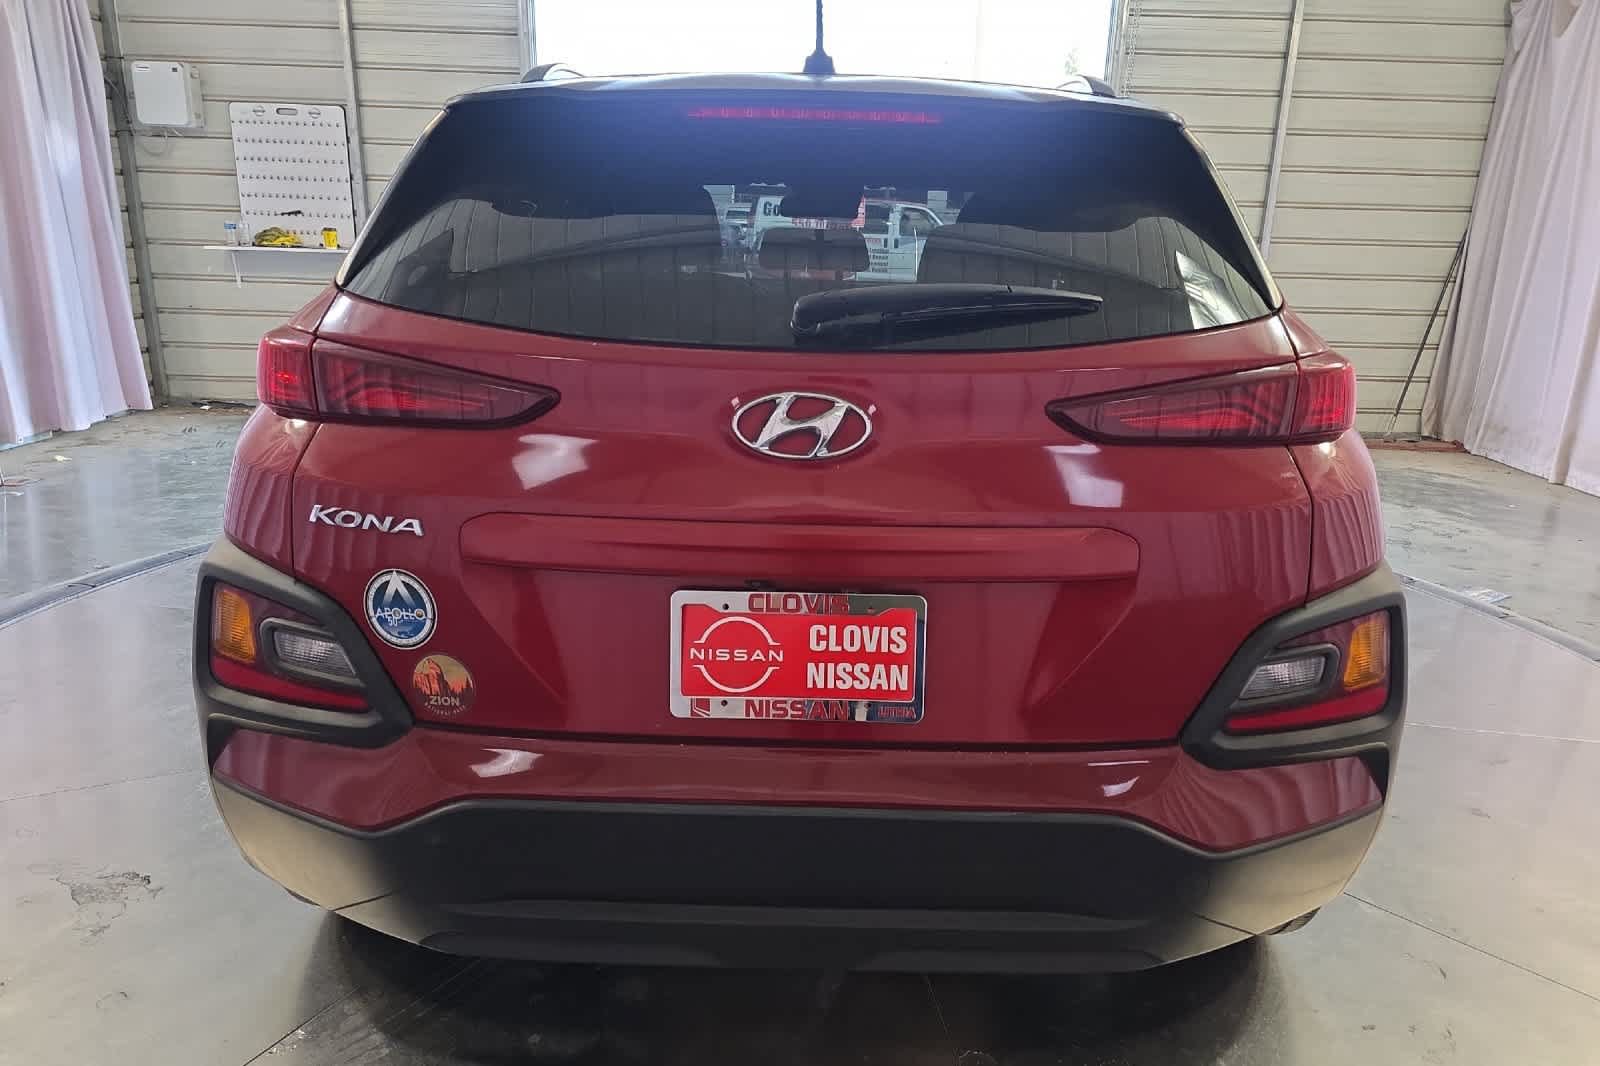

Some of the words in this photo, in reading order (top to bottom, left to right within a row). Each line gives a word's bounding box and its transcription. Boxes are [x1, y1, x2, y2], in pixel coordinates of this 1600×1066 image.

[309, 504, 425, 537] KONA
[375, 607, 425, 621] APOLLO
[748, 593, 850, 615] CLOVIS
[809, 625, 907, 654] CLOVIS
[689, 647, 784, 662] NISSAN
[807, 662, 909, 691] NISSAN
[429, 695, 460, 707] ZION
[744, 699, 849, 721] NISSAN
